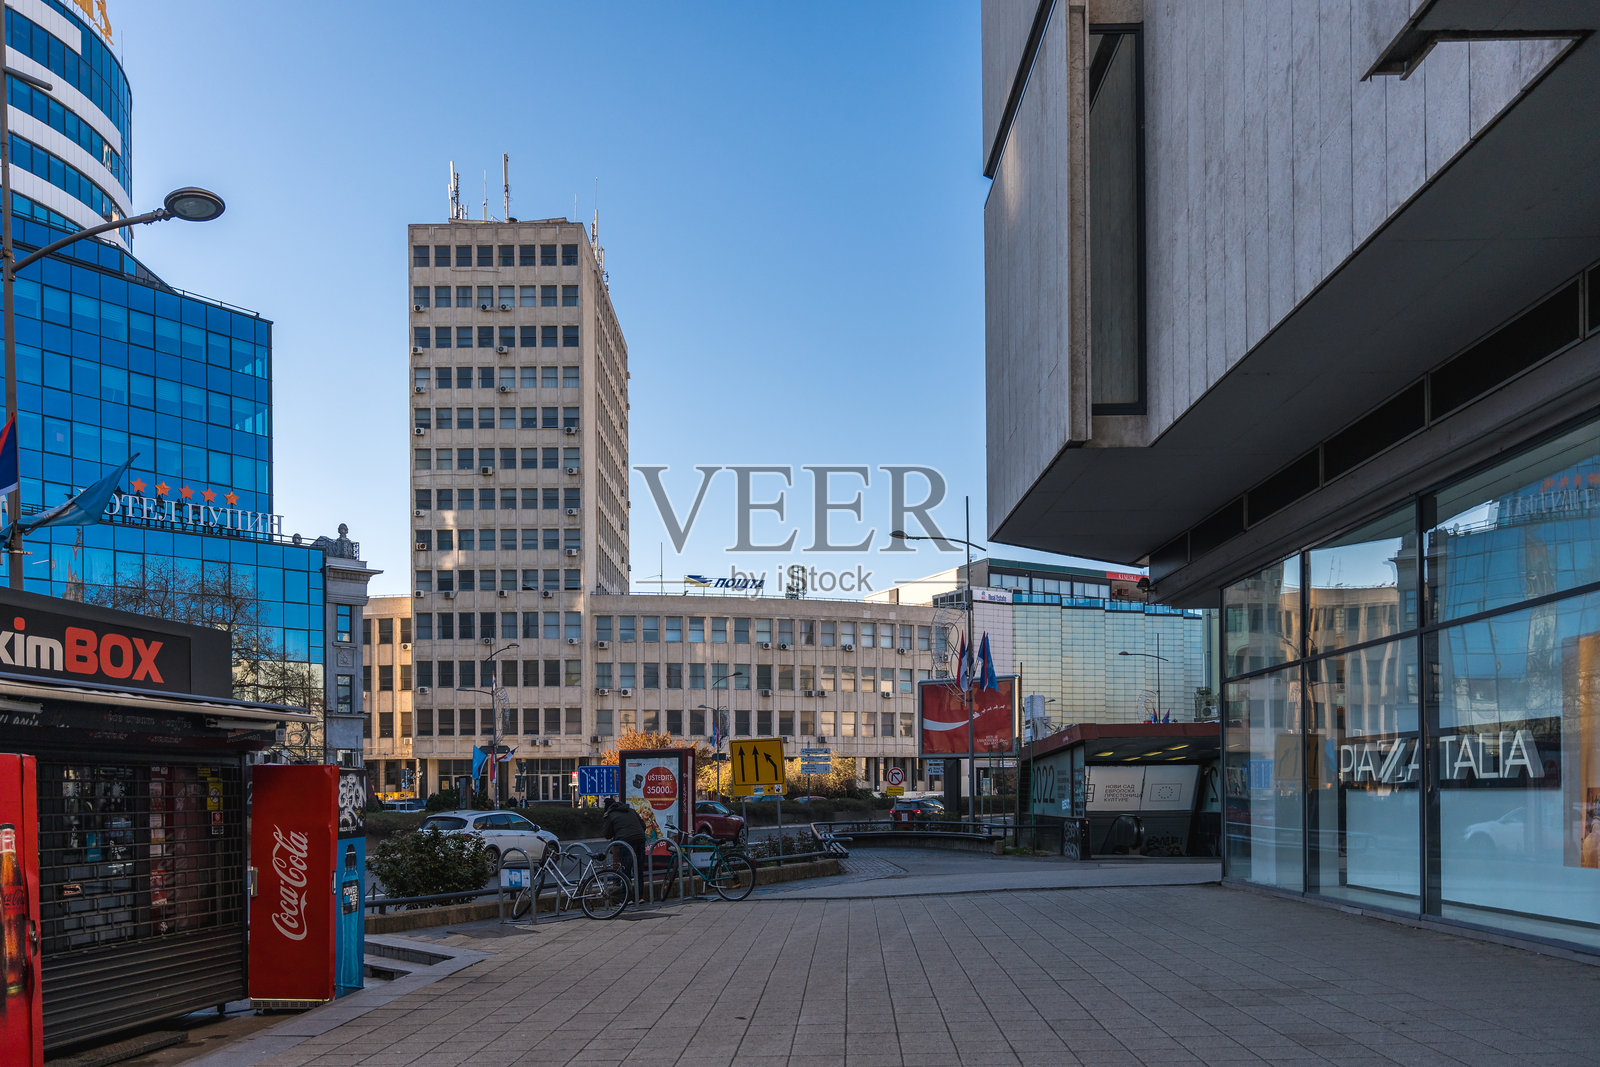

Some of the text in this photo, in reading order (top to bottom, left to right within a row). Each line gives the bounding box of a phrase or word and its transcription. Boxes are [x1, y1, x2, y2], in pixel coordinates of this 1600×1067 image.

[188, 502, 285, 535] ПУПИН
[1439, 729, 1541, 780] TALIA
[647, 773, 673, 781] UŠTEDITE
[646, 785, 670, 794] 35000
